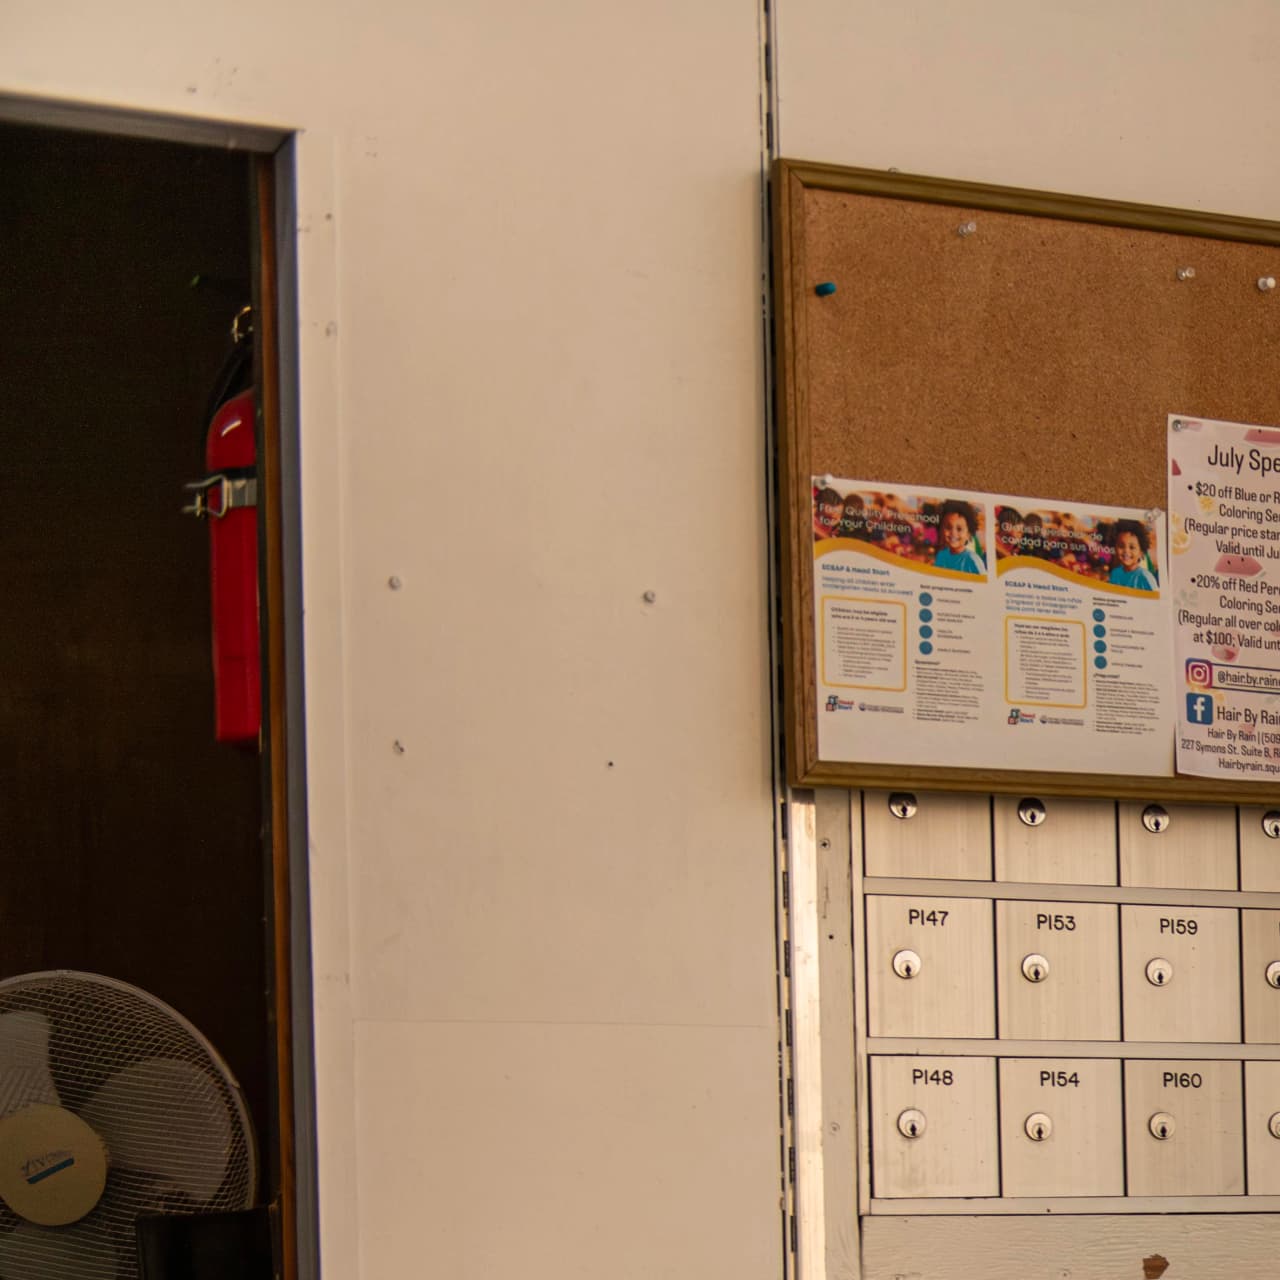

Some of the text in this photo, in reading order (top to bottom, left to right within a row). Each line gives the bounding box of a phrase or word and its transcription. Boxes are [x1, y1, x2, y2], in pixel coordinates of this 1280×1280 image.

[1207, 444, 1244, 475] July
[1196, 481, 1216, 497] $20
[1218, 486, 1233, 499] off
[1235, 487, 1257, 502] Blue
[1259, 493, 1271, 503] or
[1219, 503, 1263, 524] Coloring
[1184, 517, 1229, 536] (Regular
[1231, 525, 1258, 539] price
[1216, 539, 1241, 554] Valid
[1242, 545, 1265, 557] until
[1222, 577, 1237, 591] off
[1239, 578, 1258, 593] Red
[1219, 595, 1263, 616] Coloring
[1178, 608, 1223, 628] (Regular
[1225, 615, 1237, 628] all
[1239, 619, 1262, 630] over
[1193, 632, 1204, 644] at
[1206, 629, 1236, 648] $100;
[1238, 633, 1262, 649] Valid
[1217, 706, 1242, 722] Hair
[1244, 708, 1258, 727] By
[1207, 728, 1226, 739] Hair
[1227, 729, 1238, 742] By
[1238, 730, 1257, 742] Rain
[1241, 745, 1263, 757] Suite
